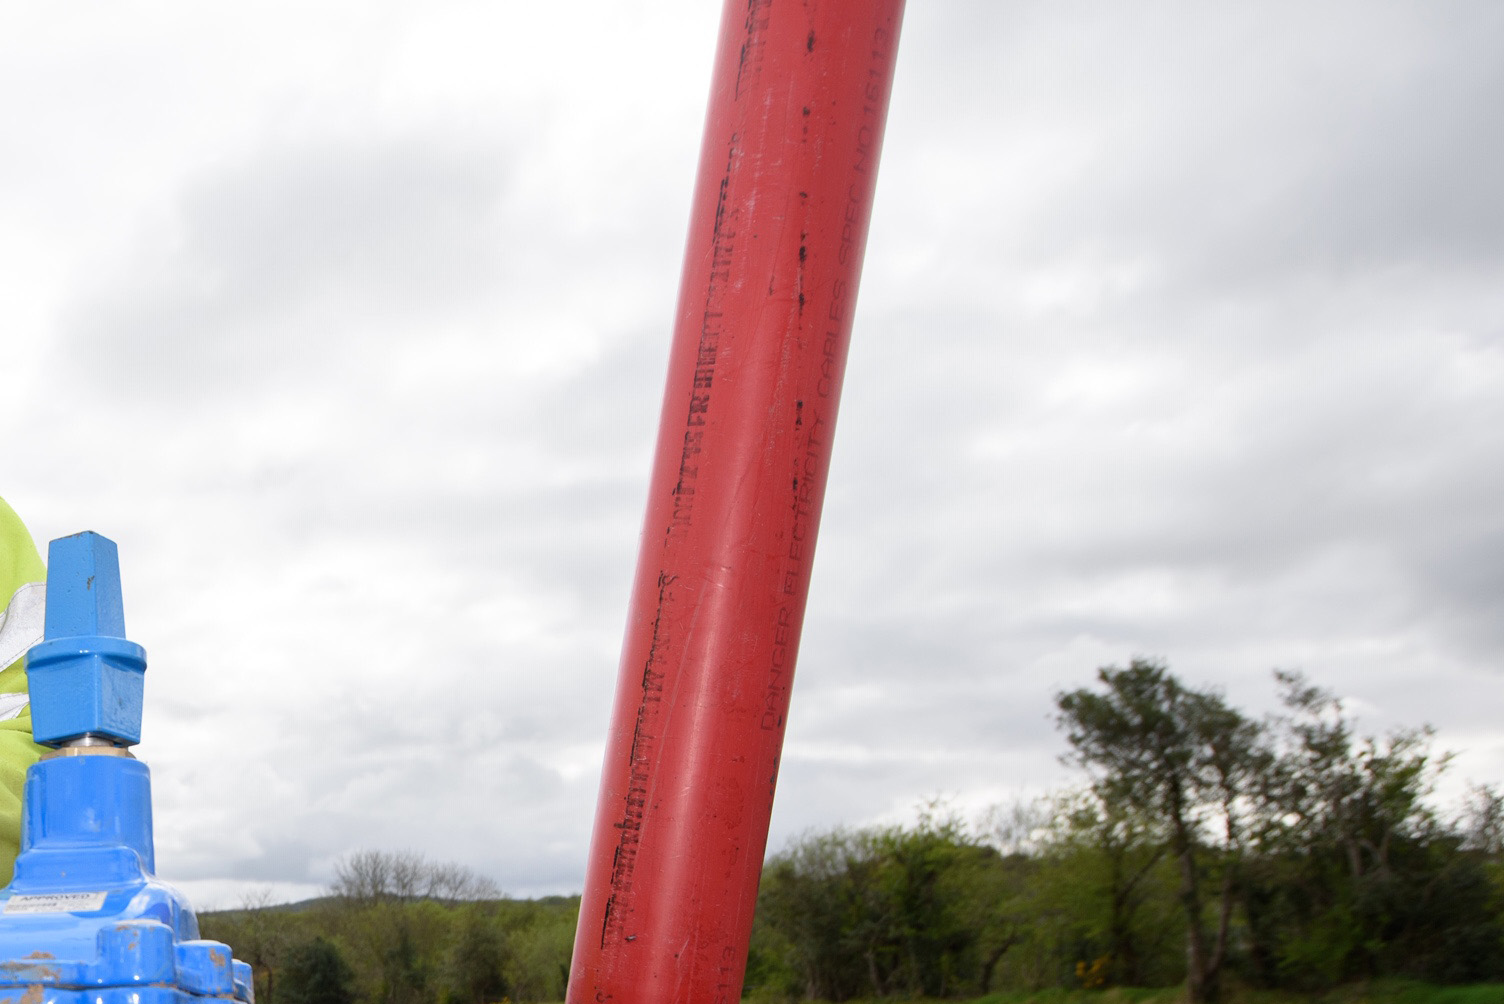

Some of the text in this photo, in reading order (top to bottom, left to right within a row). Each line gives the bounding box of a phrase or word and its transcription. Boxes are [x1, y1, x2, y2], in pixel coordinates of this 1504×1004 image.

[761, 607, 794, 732] DANGER
[784, 408, 824, 596] ELECTRICITY
[817, 278, 846, 399] CABLES
[838, 183, 863, 265] SPEC
